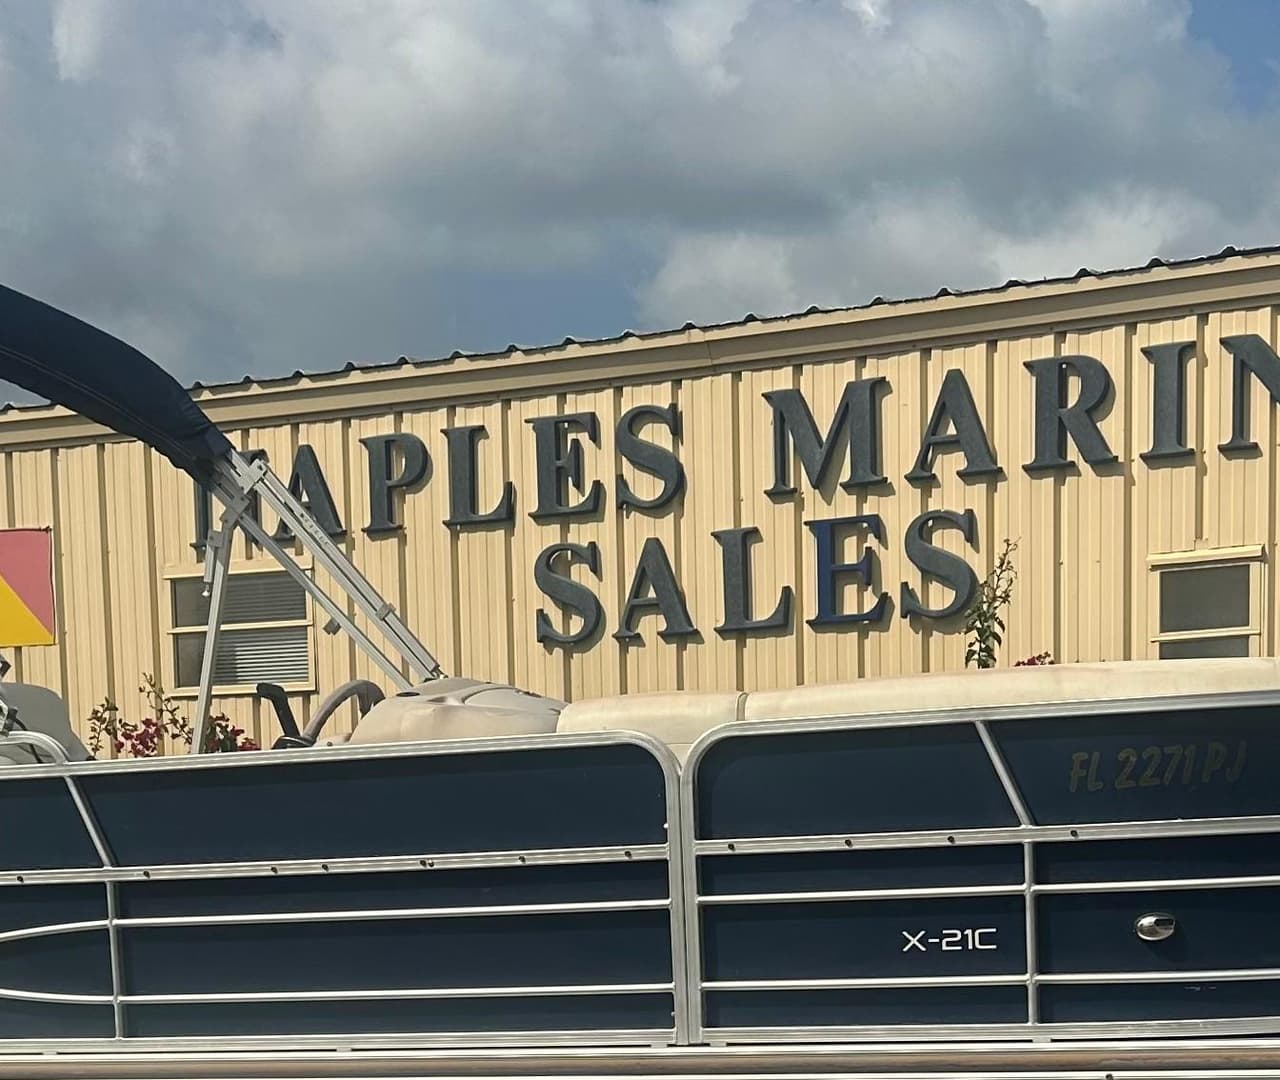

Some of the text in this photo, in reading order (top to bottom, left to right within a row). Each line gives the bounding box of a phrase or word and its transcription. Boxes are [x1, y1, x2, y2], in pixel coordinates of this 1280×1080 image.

[534, 508, 980, 645] SALES
[1070, 740, 1247, 792] FL 2271 PJ
[902, 928, 997, 952] X-21C
